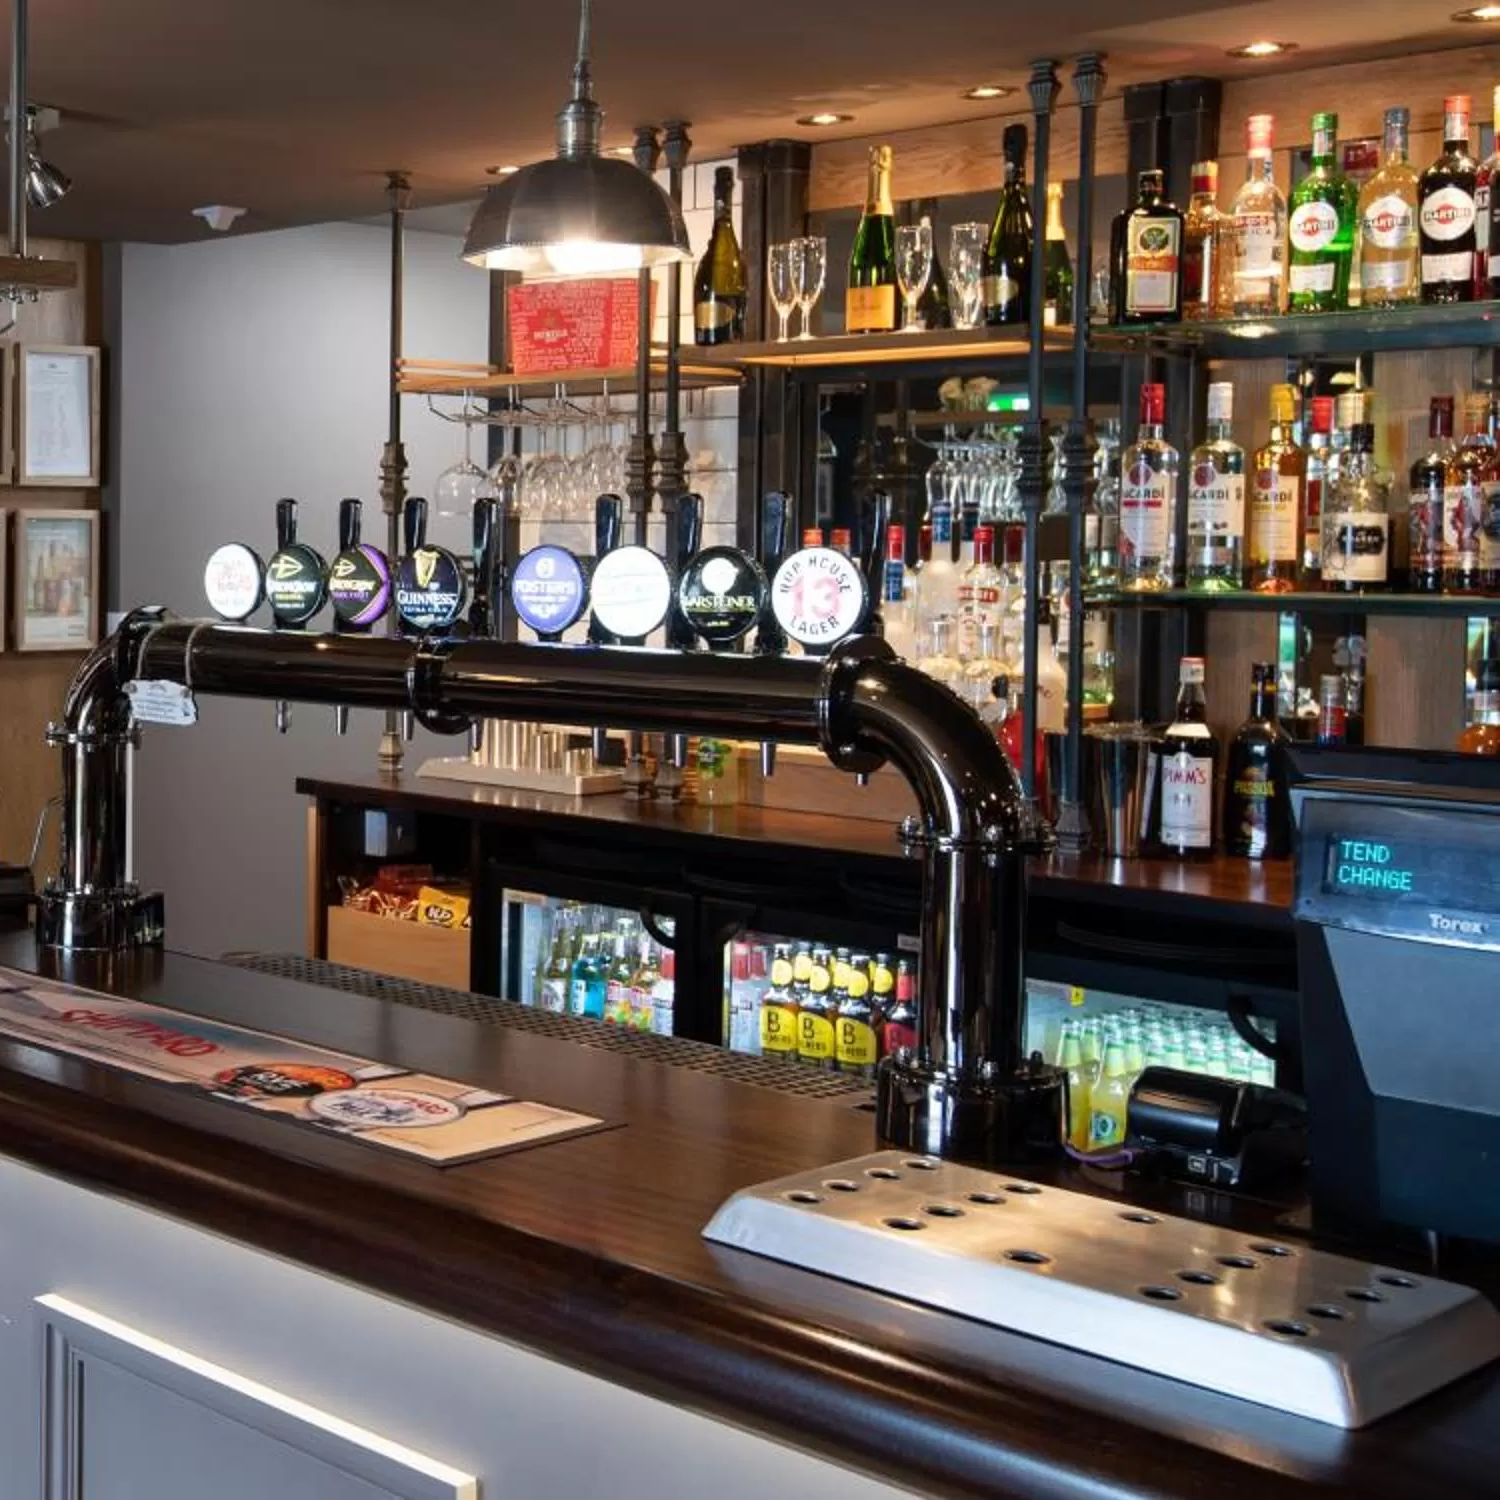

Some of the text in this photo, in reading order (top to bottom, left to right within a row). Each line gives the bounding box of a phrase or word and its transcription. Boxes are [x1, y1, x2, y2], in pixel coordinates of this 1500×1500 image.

[398, 590, 457, 605] GUINNESS
[793, 575, 843, 620] 13
[789, 614, 841, 636] LAGER
[1341, 840, 1391, 863] TEND
[1337, 864, 1414, 891] CHANGE
[428, 907, 451, 920] KP
[1428, 912, 1485, 935] Torex
[767, 1011, 781, 1033] B
[803, 1017, 815, 1039] B
[843, 1022, 855, 1045] B
